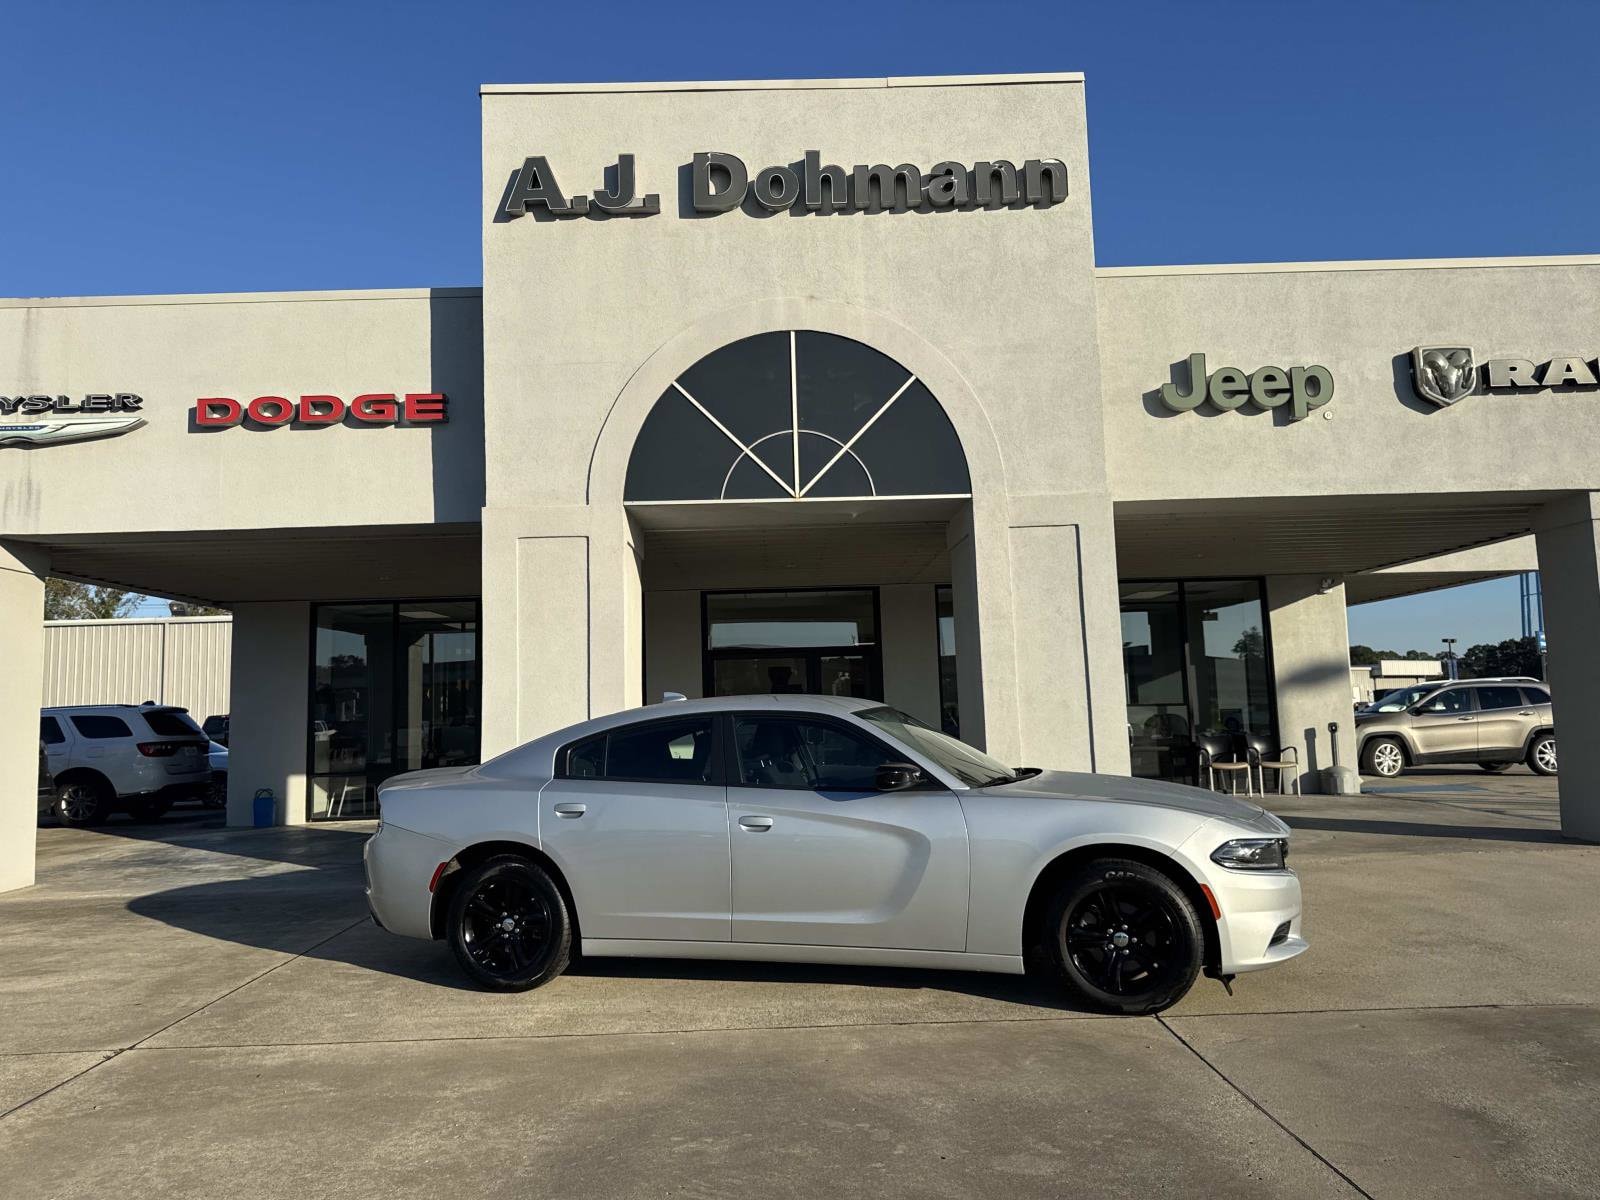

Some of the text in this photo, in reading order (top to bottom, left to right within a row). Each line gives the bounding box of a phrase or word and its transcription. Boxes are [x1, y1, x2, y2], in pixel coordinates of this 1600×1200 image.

[505, 150, 1069, 214] A.J. Dohmann
[1161, 352, 1335, 420] Jeep
[1488, 356, 1600, 387] RA
[196, 394, 445, 426] DODGE
